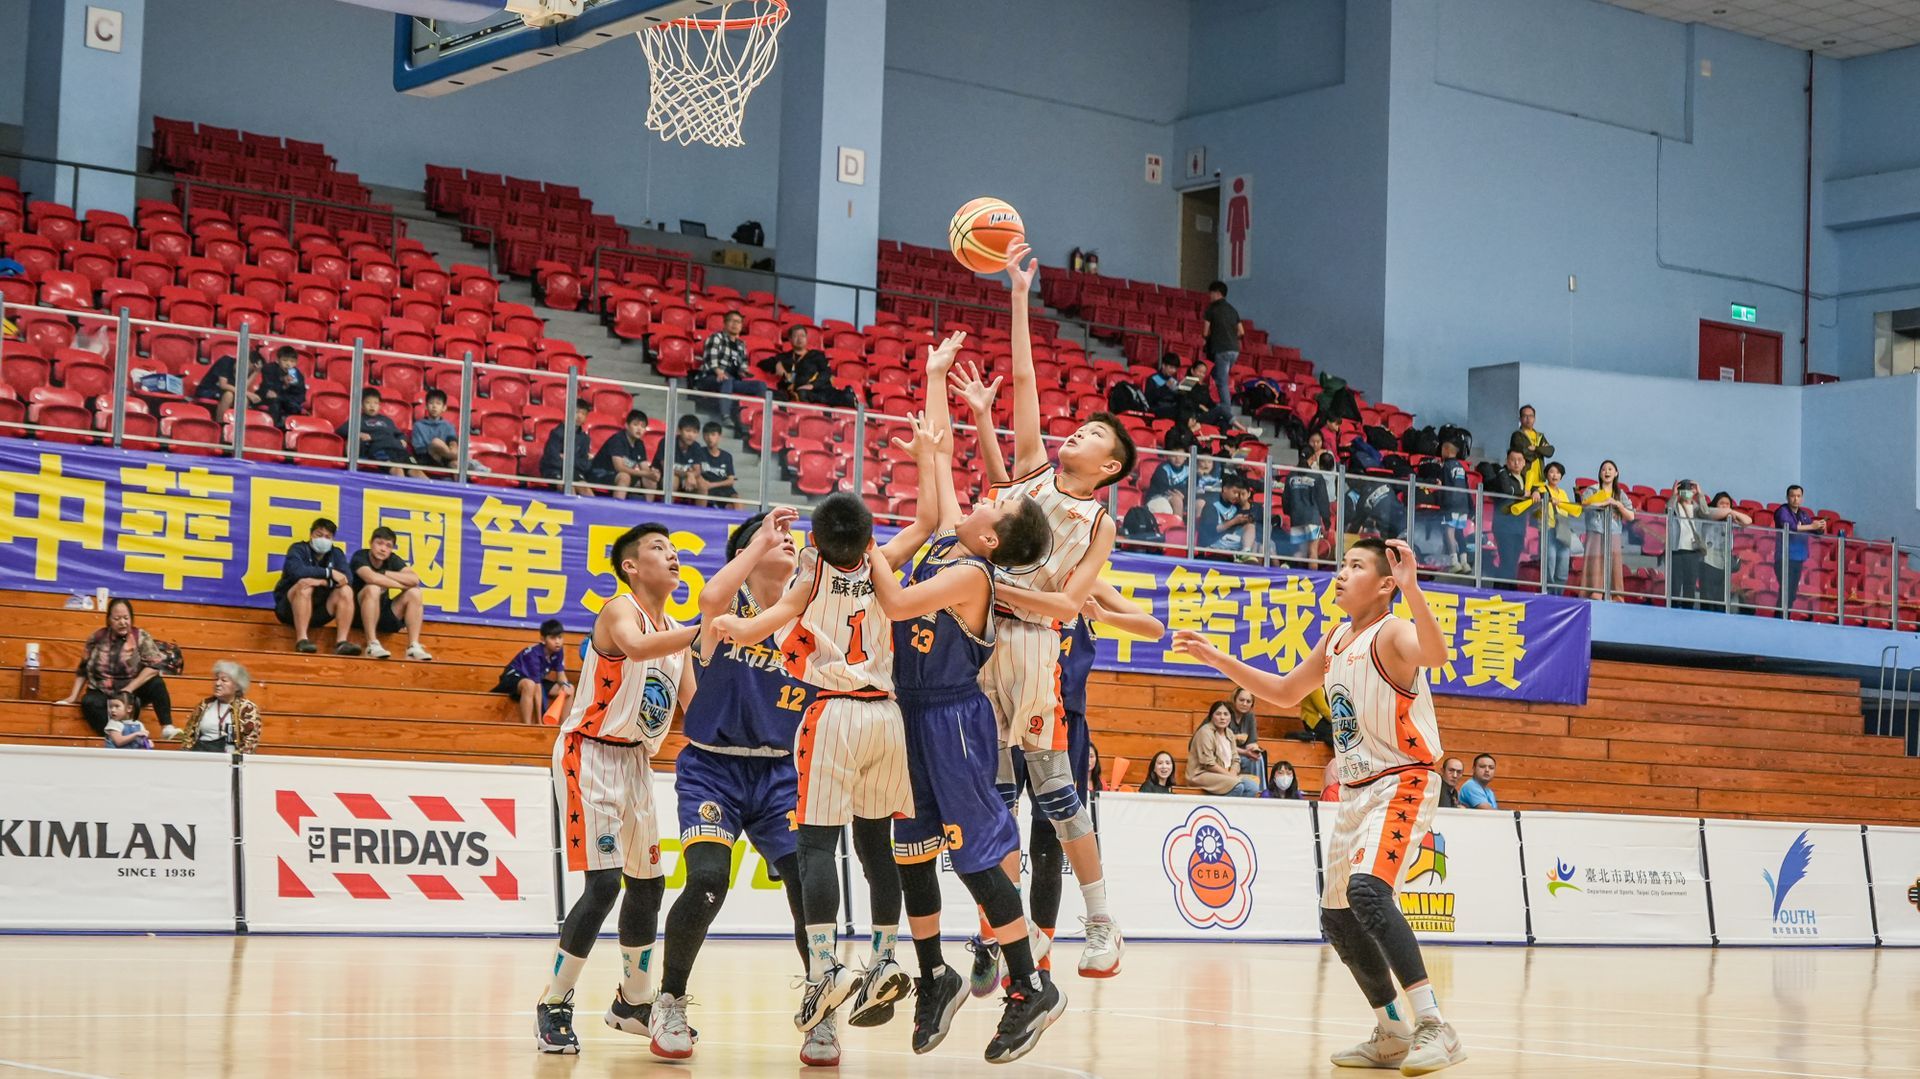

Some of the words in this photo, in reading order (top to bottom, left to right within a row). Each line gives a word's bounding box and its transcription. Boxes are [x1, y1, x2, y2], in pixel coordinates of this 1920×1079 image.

[95, 17, 113, 42] C
[845, 155, 859, 176] D
[845, 609, 868, 665] 1
[776, 685, 806, 711] 12
[1029, 716, 1044, 735] 2
[0, 819, 197, 861] KIMLAN
[308, 827, 325, 863] TGI
[330, 827, 489, 867] FRIDAYS
[649, 844, 660, 865] 3
[117, 867, 157, 877] SINCE
[164, 868, 196, 878] 1936
[1197, 869, 1229, 879] CTBA
[1400, 892, 1455, 916] MINI
[1409, 921, 1453, 931] ASKETBALL
